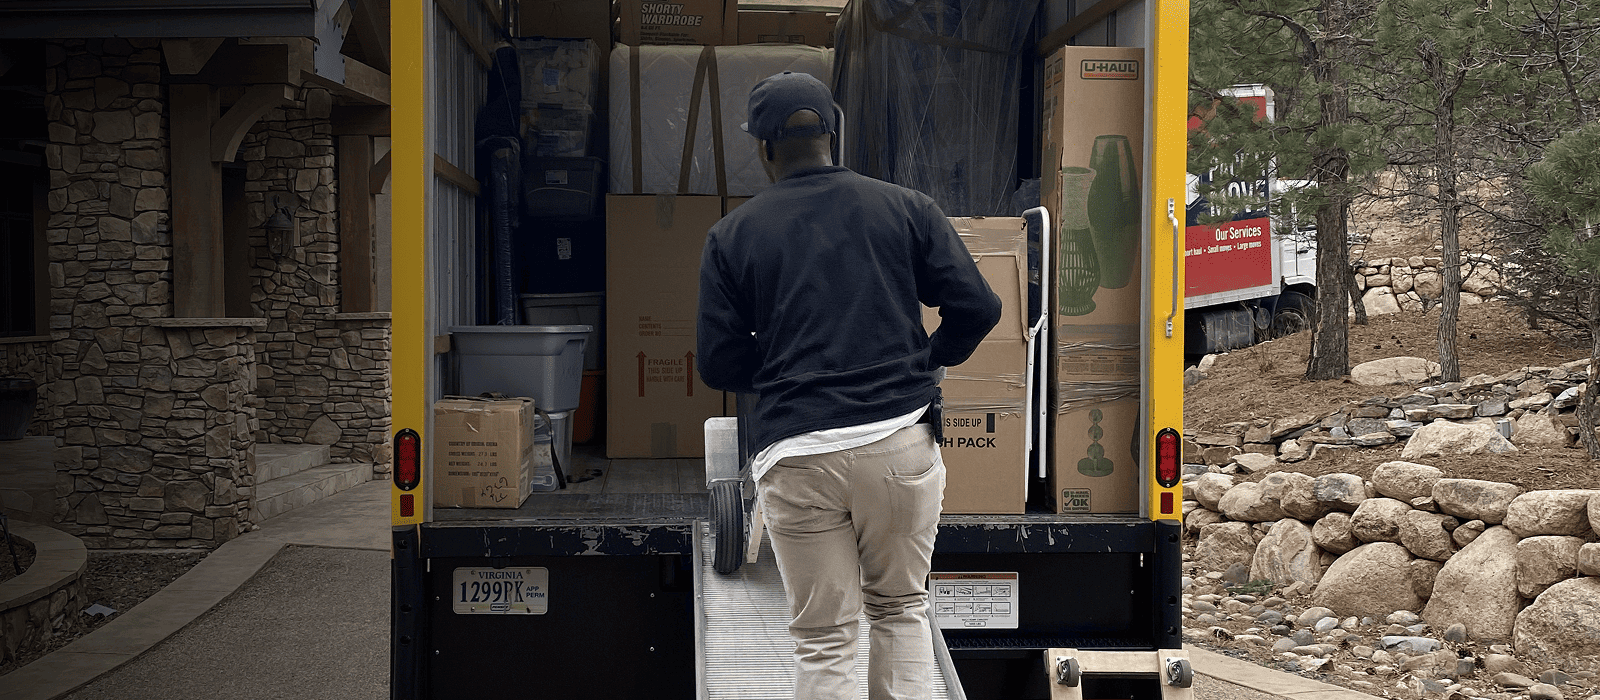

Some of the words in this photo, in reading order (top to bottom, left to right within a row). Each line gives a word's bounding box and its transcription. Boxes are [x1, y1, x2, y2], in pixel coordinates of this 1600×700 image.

[641, 3, 684, 14] SHORTY
[641, 14, 704, 26] WARDROBE
[1084, 62, 1135, 73] U-HAUL
[1215, 228, 1228, 241] Our
[1229, 225, 1262, 240] Services
[1208, 245, 1219, 254] Small
[1237, 242, 1249, 251] Large
[648, 358, 684, 366] FRAGILE
[952, 417, 970, 428] SIDE
[971, 418, 982, 428] UP
[957, 437, 996, 448] PACK
[1072, 498, 1089, 507] OK
[478, 571, 524, 580] VIRGINIA
[460, 580, 525, 603] 1299PK
